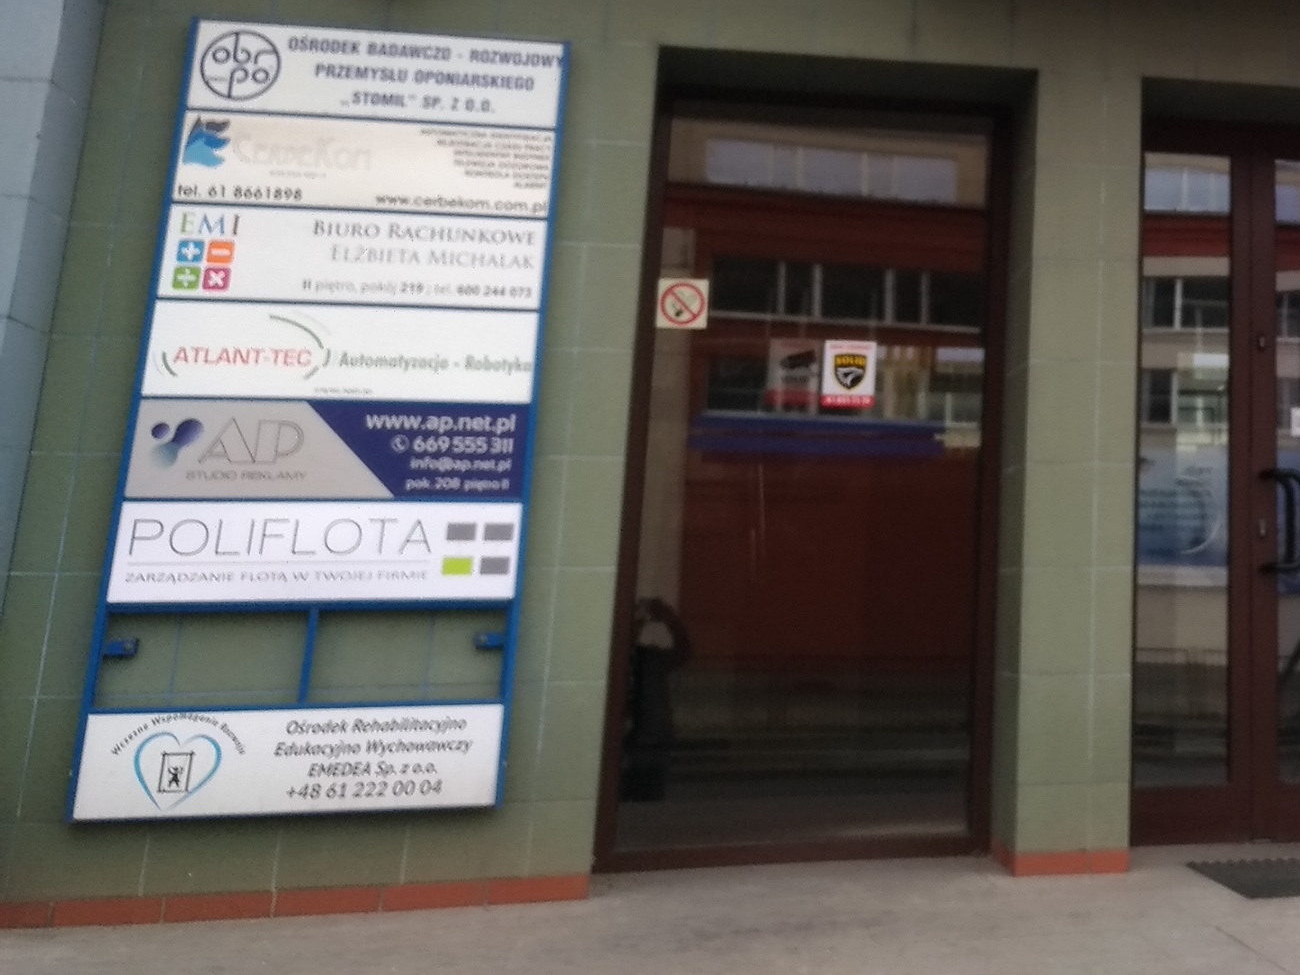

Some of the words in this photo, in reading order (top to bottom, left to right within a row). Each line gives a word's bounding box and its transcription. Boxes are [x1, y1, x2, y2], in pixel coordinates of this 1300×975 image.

[288, 34, 360, 54] OŚRODEK
[368, 40, 451, 62] BADAWCZO
[414, 69, 535, 91] OPONIARSKIEGO
[178, 184, 200, 198] tel.
[208, 185, 226, 198] 61
[233, 185, 303, 201] 8661898
[312, 219, 381, 239] BIURO
[388, 222, 536, 246] RACHUNKOWE
[428, 249, 535, 269] MICHALAK
[173, 346, 312, 367] ATLANT-TEC
[365, 413, 516, 435] www.ap.net.pl
[412, 435, 450, 454] 669
[452, 436, 489, 455] 555
[489, 437, 514, 455] 311
[128, 517, 432, 557] POLIFLOTA
[286, 782, 322, 800] +48
[325, 782, 347, 799] 61
[351, 780, 389, 798] 222
[391, 780, 416, 797] 00
[419, 779, 443, 796] 04
